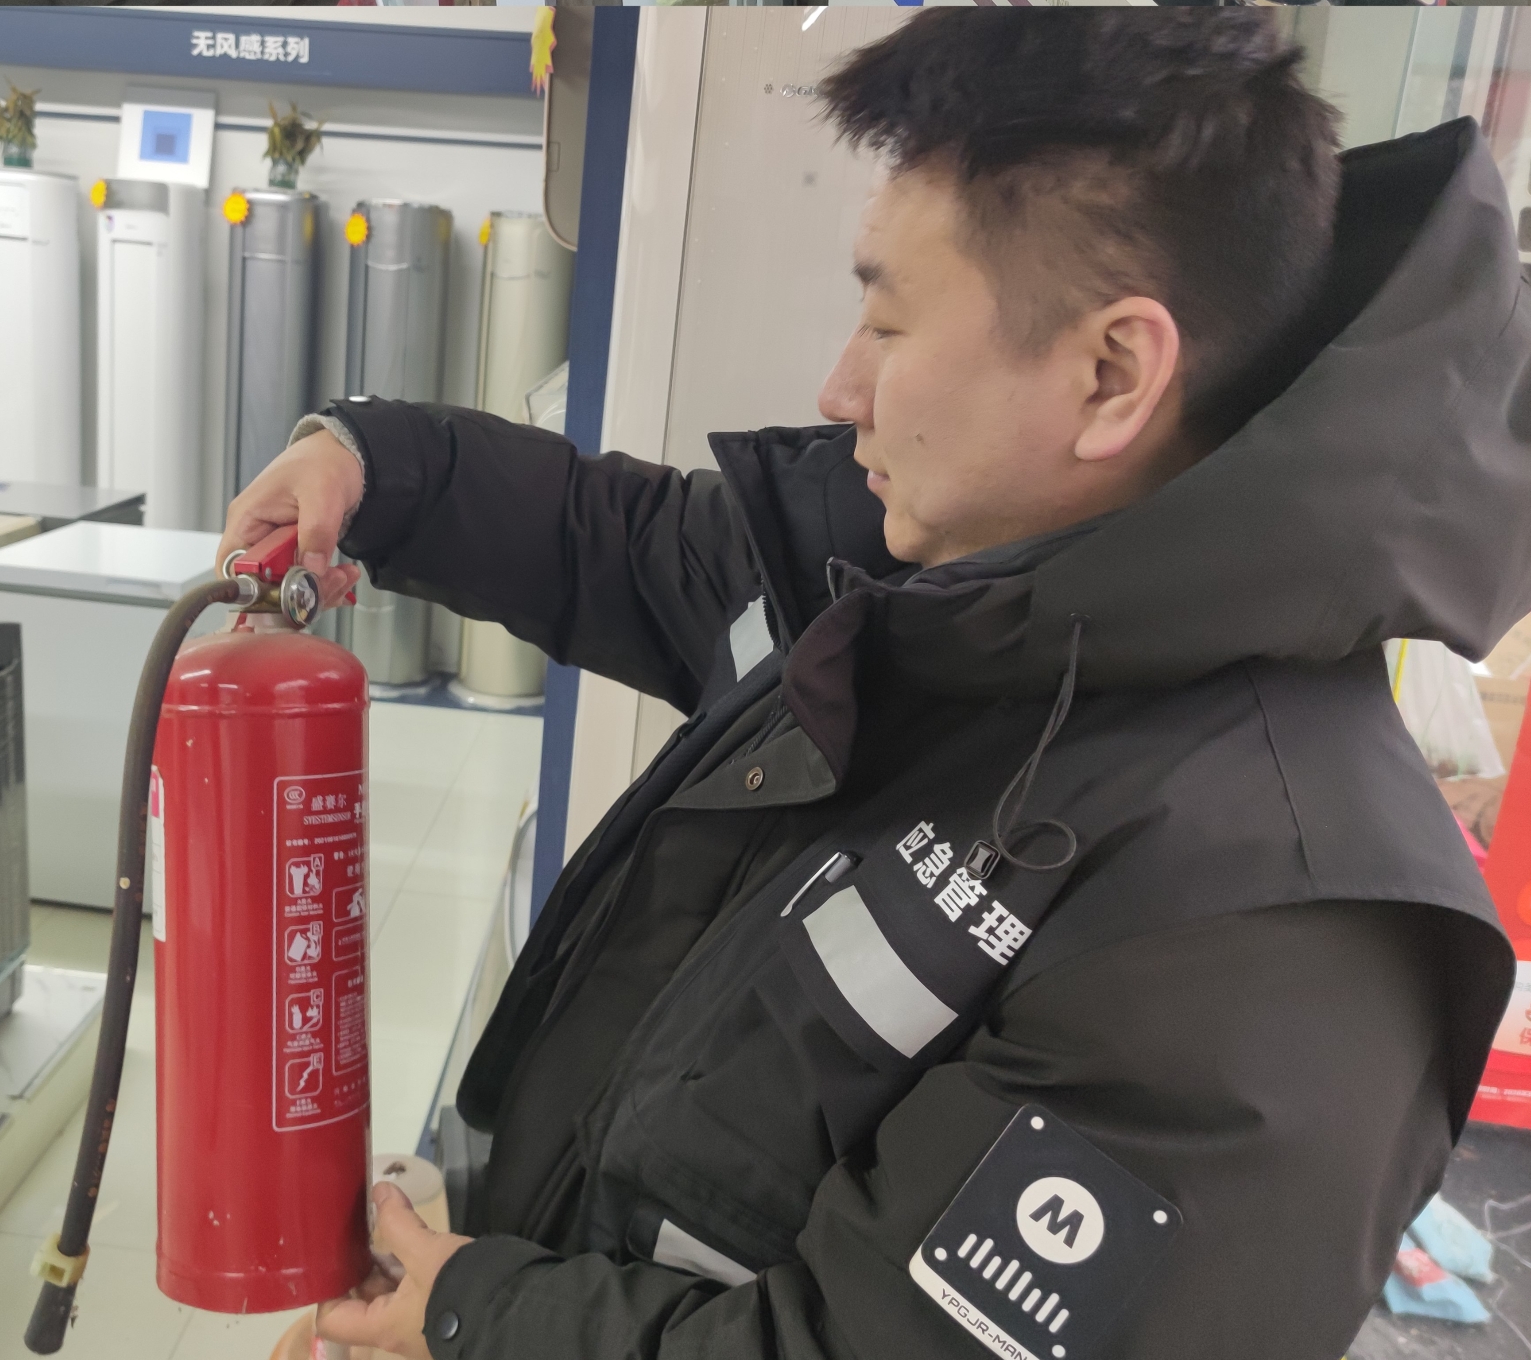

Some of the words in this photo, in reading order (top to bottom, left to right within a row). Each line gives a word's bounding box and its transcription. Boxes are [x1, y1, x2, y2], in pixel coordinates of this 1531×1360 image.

[189, 31, 312, 65] 无风感系列
[894, 819, 1033, 967] 应急管理
[1029, 1193, 1085, 1249] M
